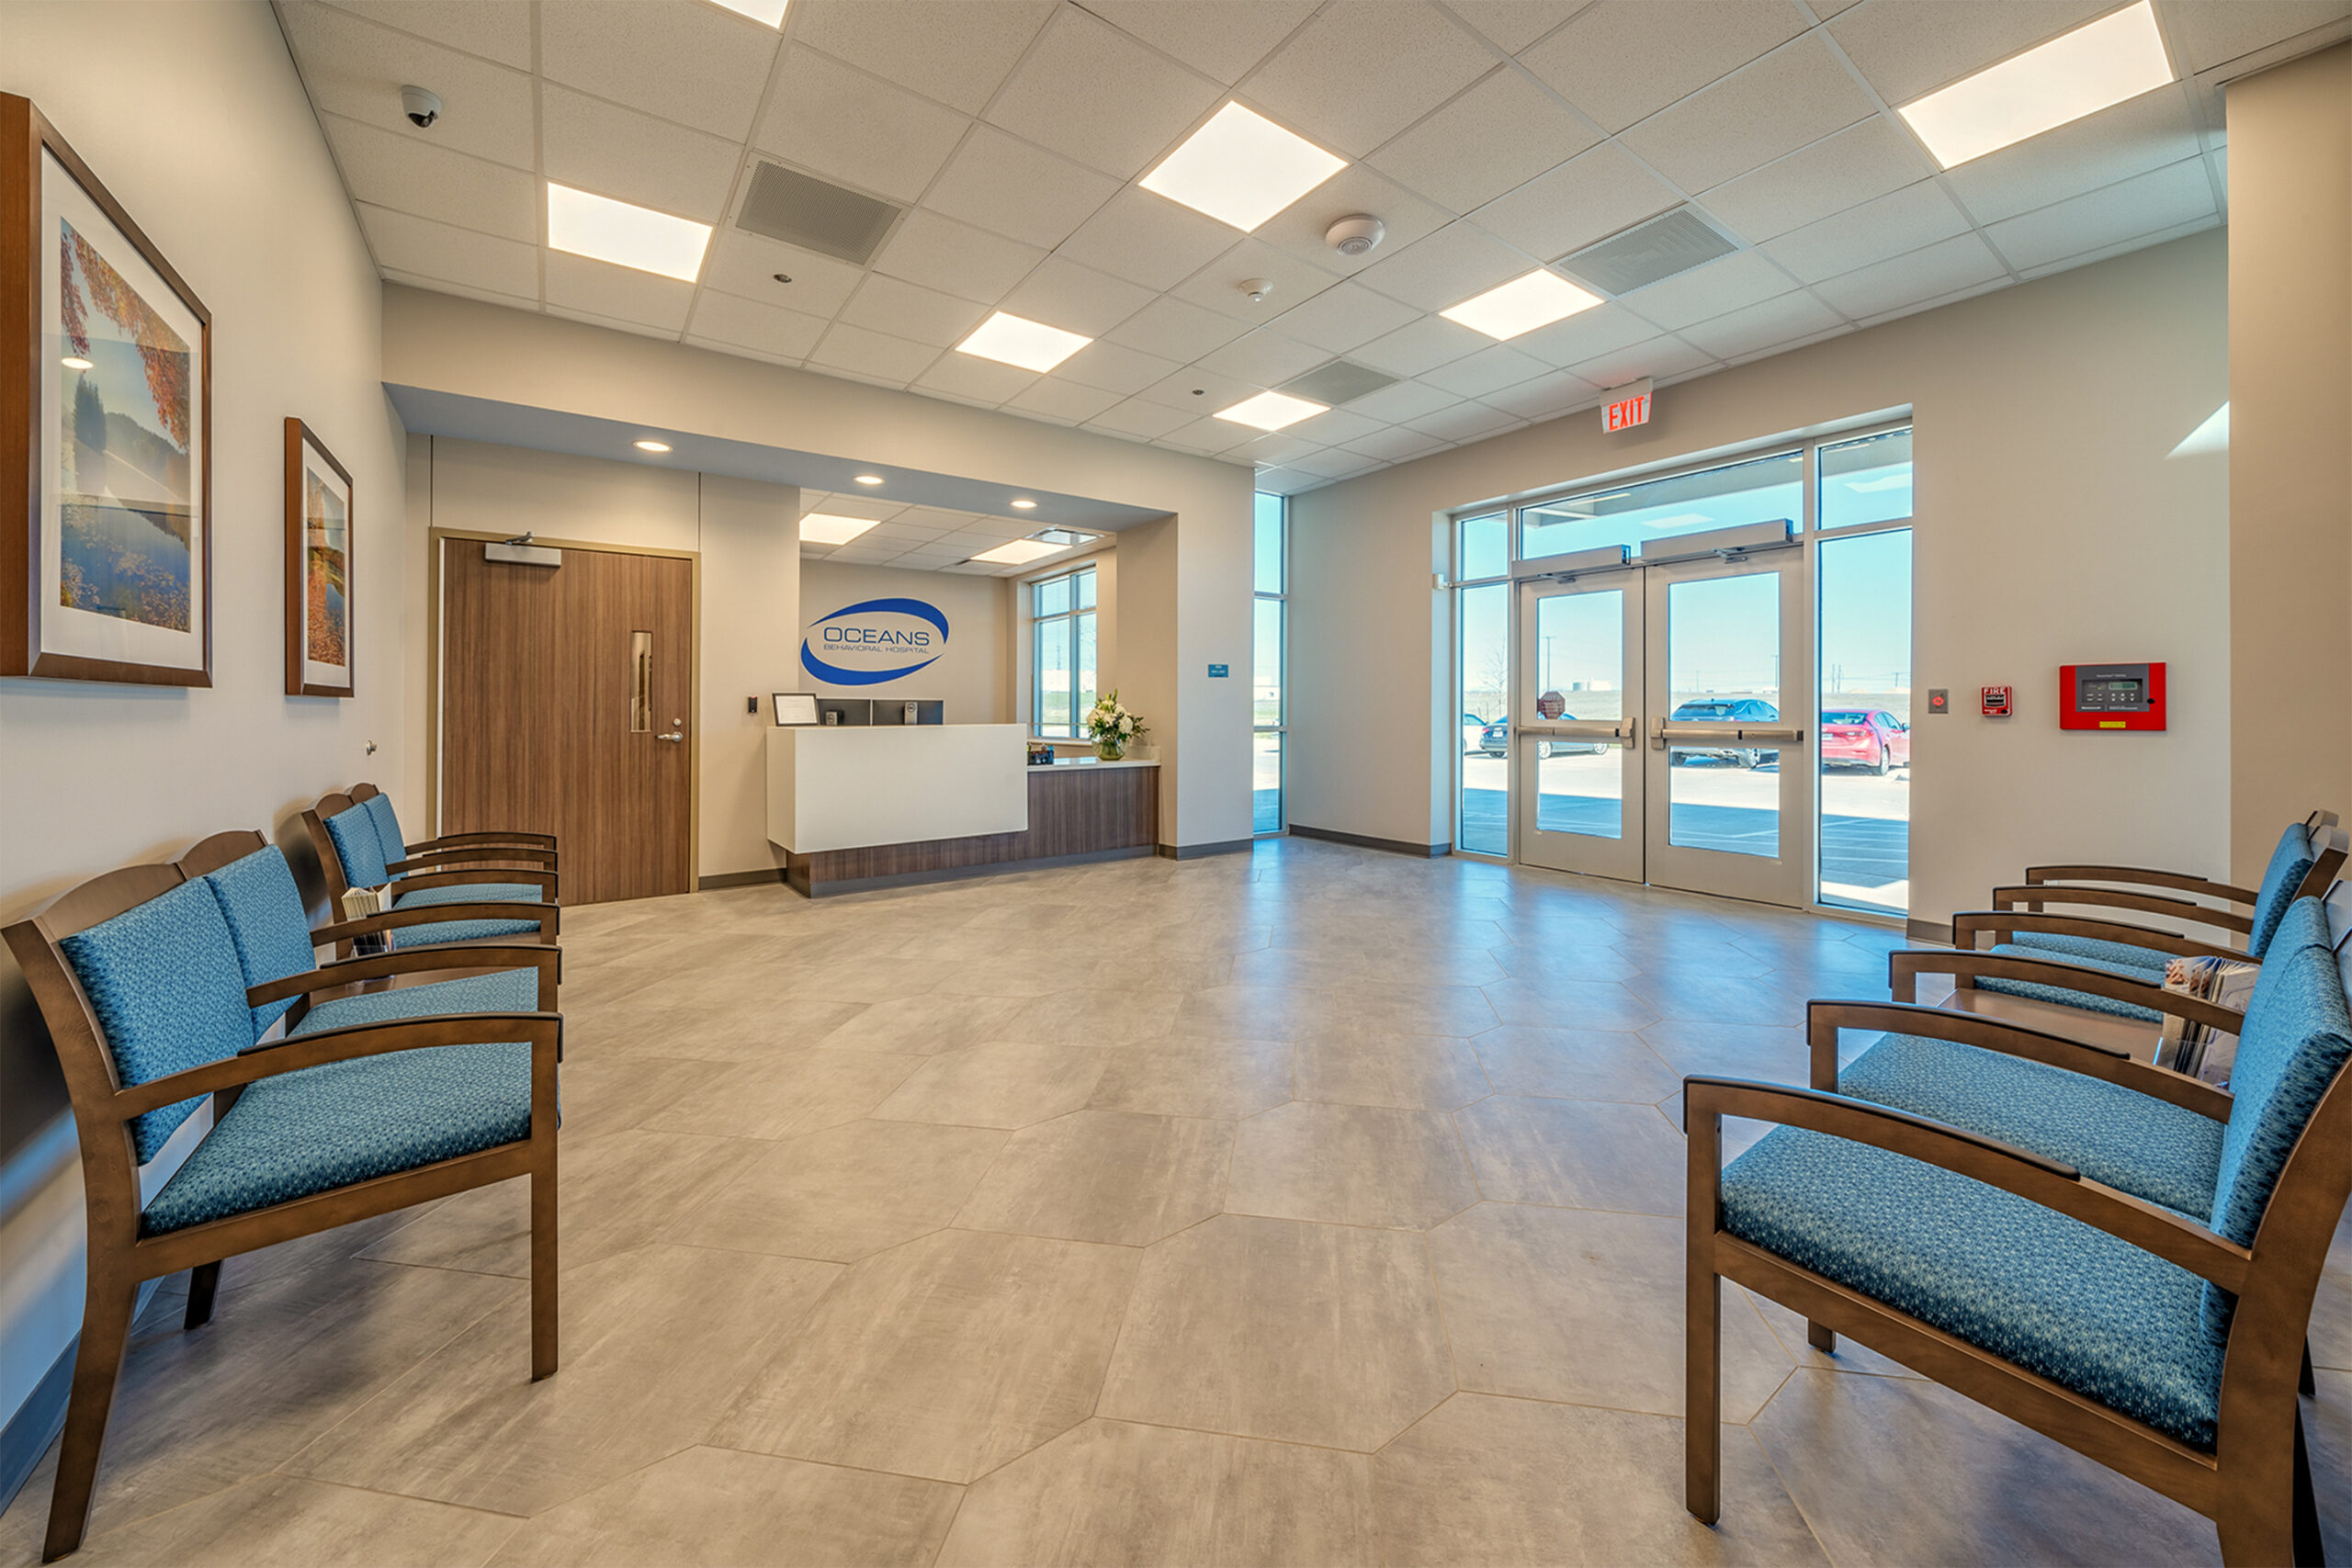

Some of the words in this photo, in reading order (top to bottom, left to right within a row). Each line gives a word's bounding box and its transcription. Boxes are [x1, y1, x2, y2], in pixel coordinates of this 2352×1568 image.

[1609, 396, 1645, 431] EXIT
[824, 626, 930, 646] OCEANS
[823, 643, 883, 653] BEHAVIORAL
[886, 646, 930, 655] HOSPITAL
